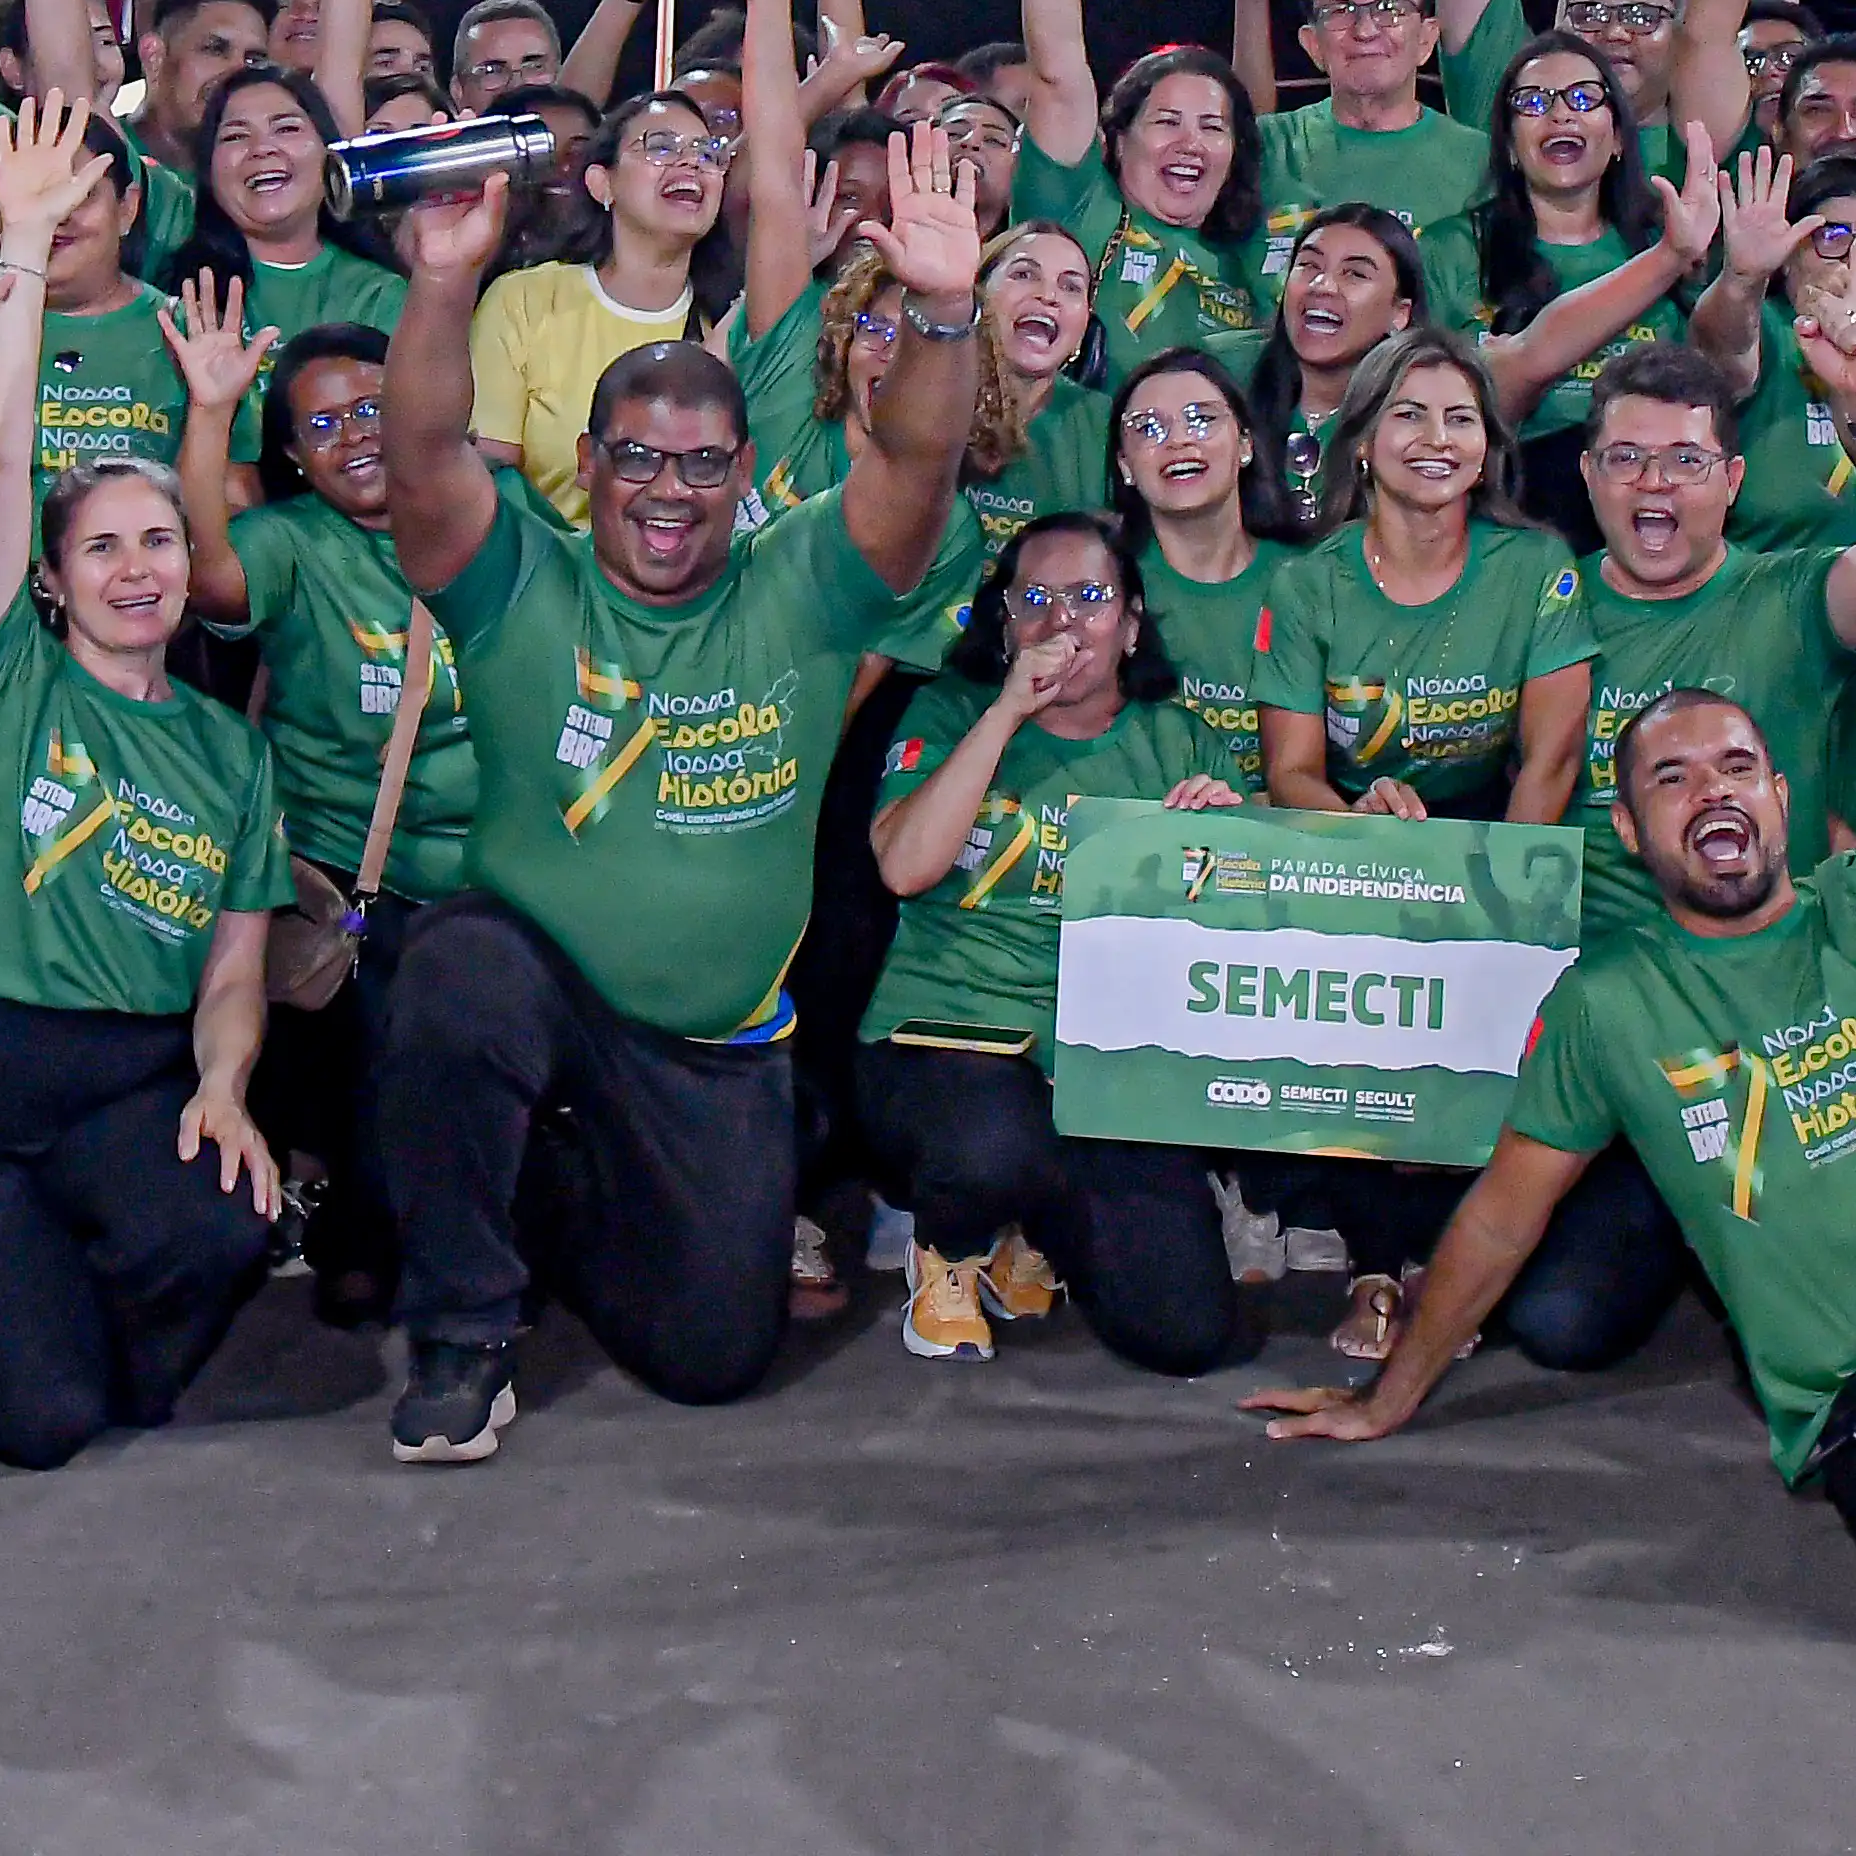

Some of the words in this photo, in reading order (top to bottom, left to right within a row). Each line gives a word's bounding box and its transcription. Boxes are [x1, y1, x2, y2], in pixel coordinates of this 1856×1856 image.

[42, 383, 133, 402] Nossa
[41, 401, 169, 435] Escola
[41, 427, 131, 451] Nossa
[1182, 676, 1246, 702] Noss
[1407, 674, 1487, 698] Nossa
[648, 687, 736, 717] Nossa
[1408, 687, 1518, 726] Escola
[654, 703, 781, 749] Escola
[657, 757, 798, 808] História
[1271, 858, 1345, 876] PARADA
[1356, 861, 1426, 881] CÍVICA
[1269, 873, 1300, 892] DA
[1303, 875, 1467, 904] INDEPENDÊNCIA
[1185, 959, 1446, 1031] SEMECTI
[1206, 1080, 1272, 1106] CODÓ
[1279, 1084, 1348, 1104] SEMECTI
[1354, 1089, 1416, 1108] SECULT
